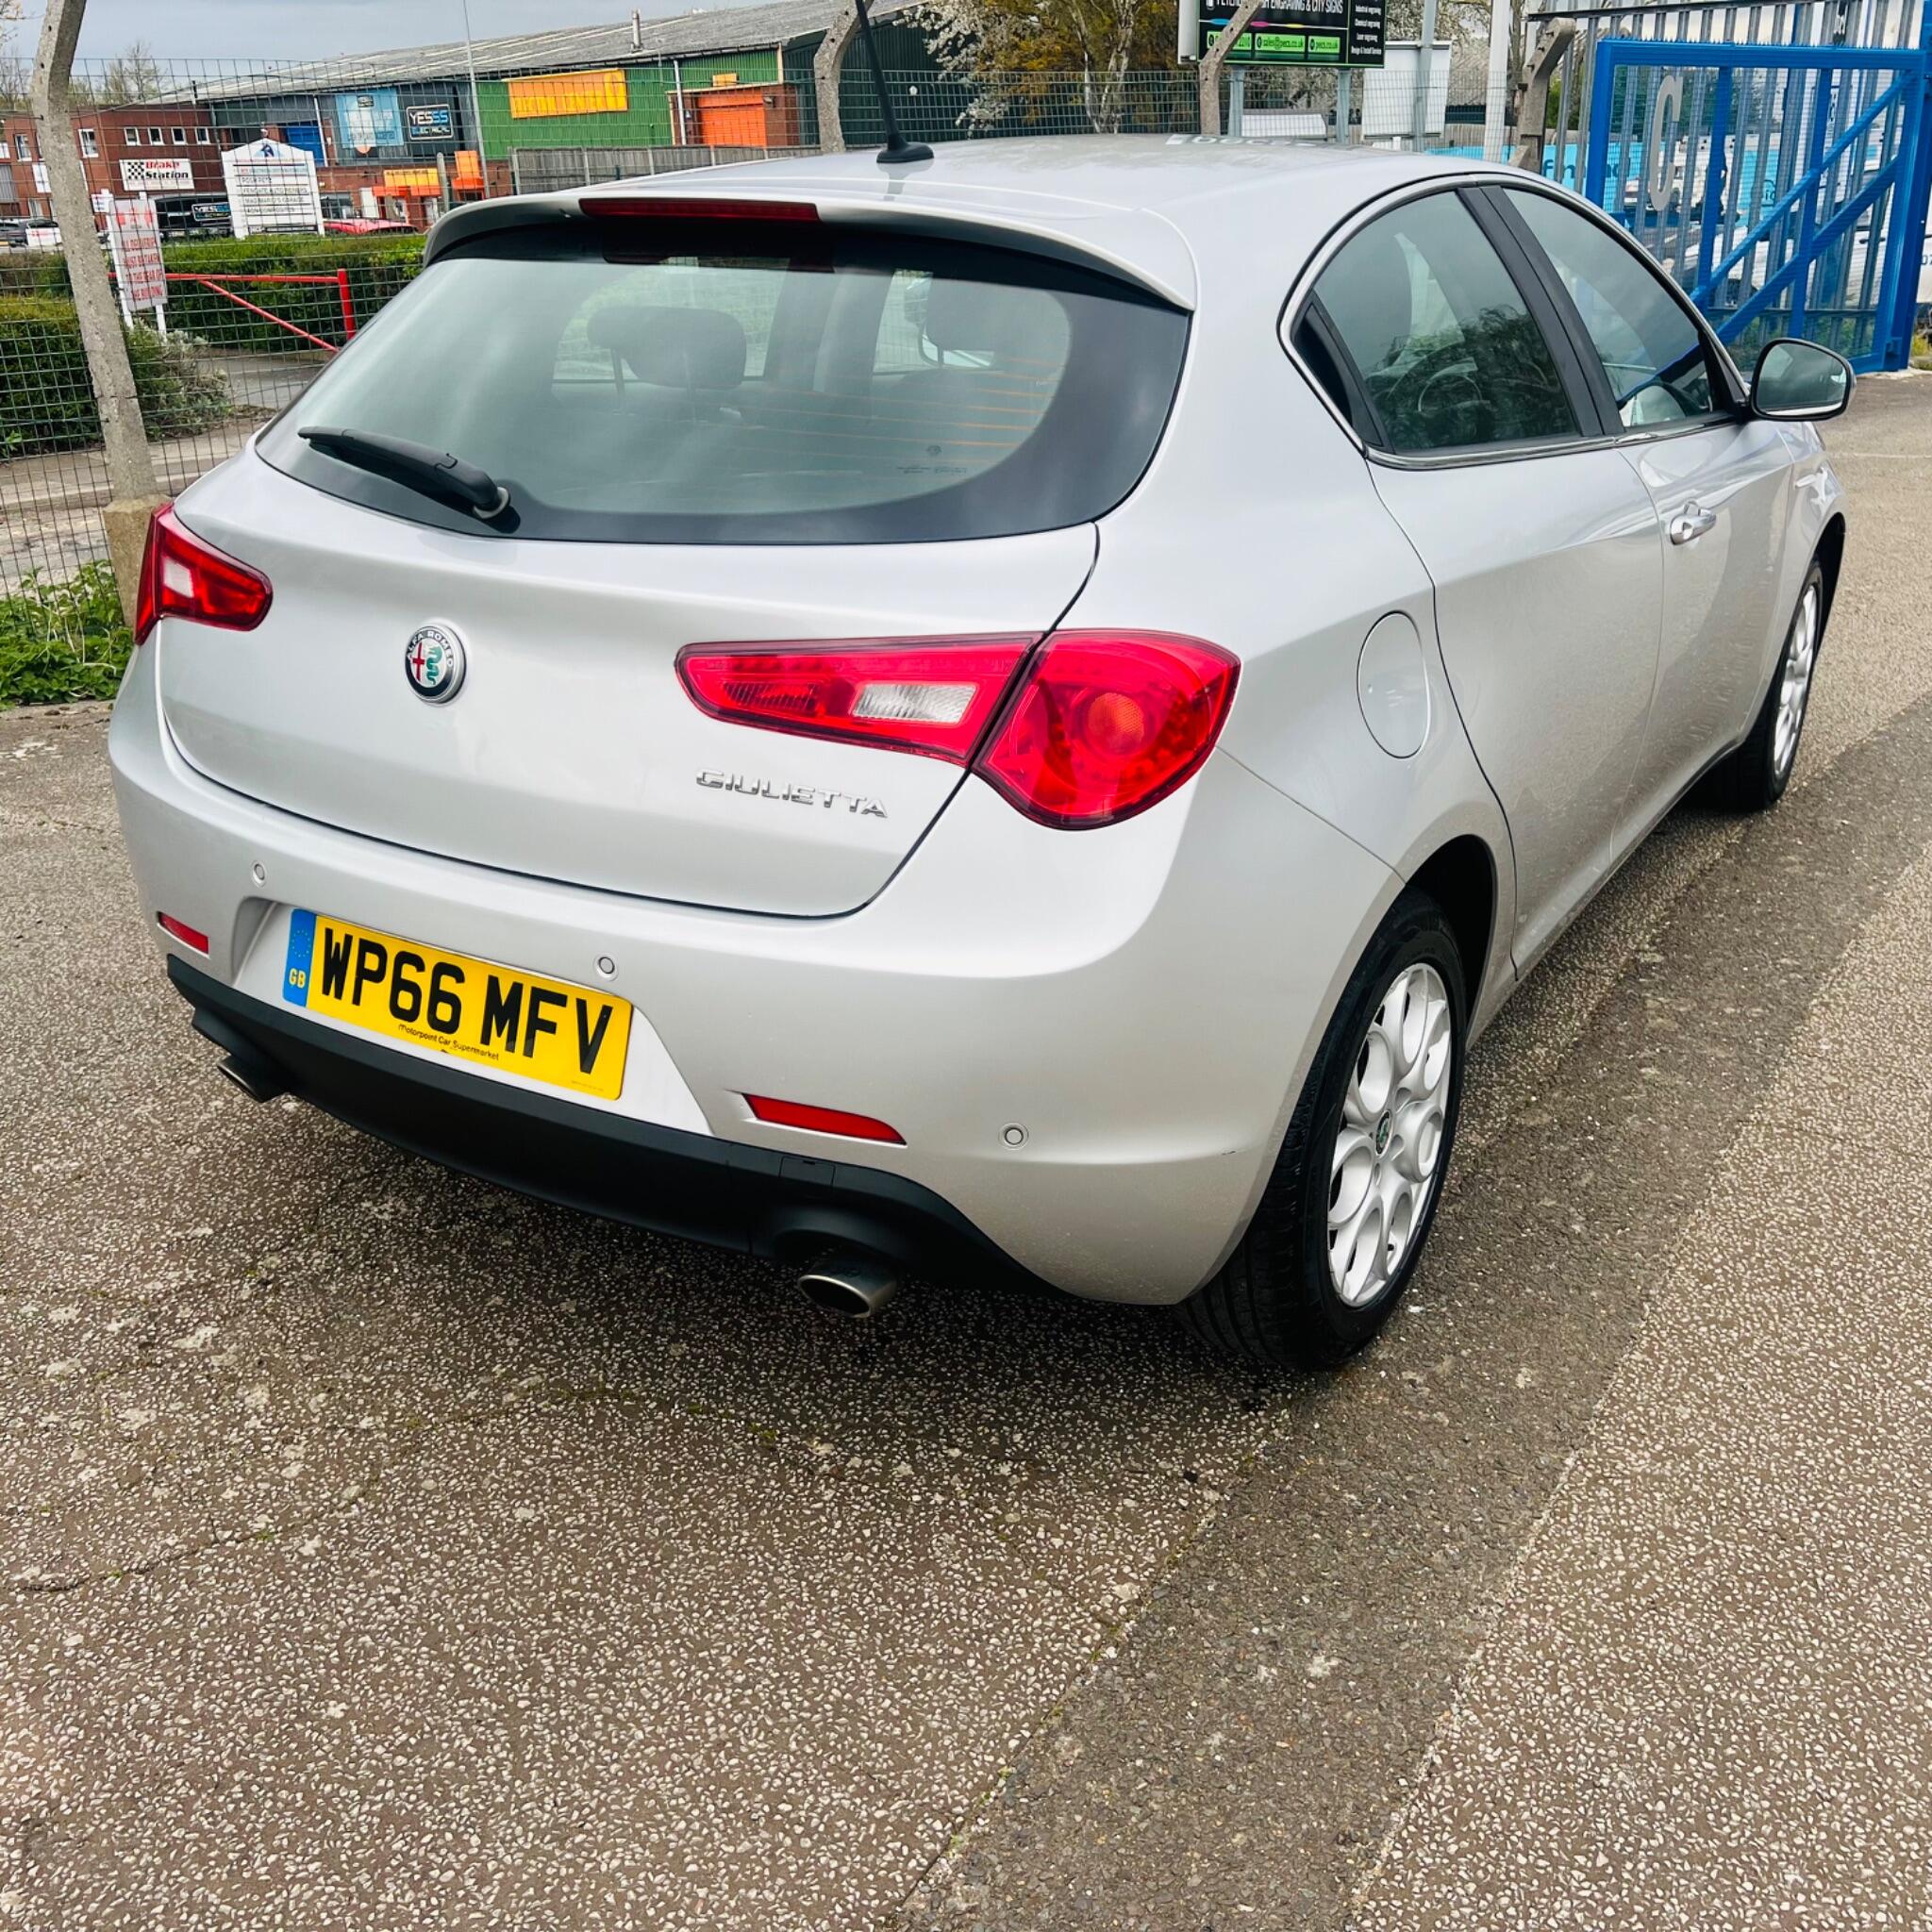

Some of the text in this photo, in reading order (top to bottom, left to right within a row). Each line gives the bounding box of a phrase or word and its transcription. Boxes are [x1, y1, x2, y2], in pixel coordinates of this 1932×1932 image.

[409, 109, 449, 125] YESSS
[145, 160, 180, 170] Brake
[145, 171, 189, 179] Station
[695, 768, 889, 819] GIULIETTA
[288, 968, 306, 989] GB
[322, 926, 614, 1074] WP66 MFV
[438, 1036, 451, 1045] Car
[453, 1041, 499, 1061] Supermarket
